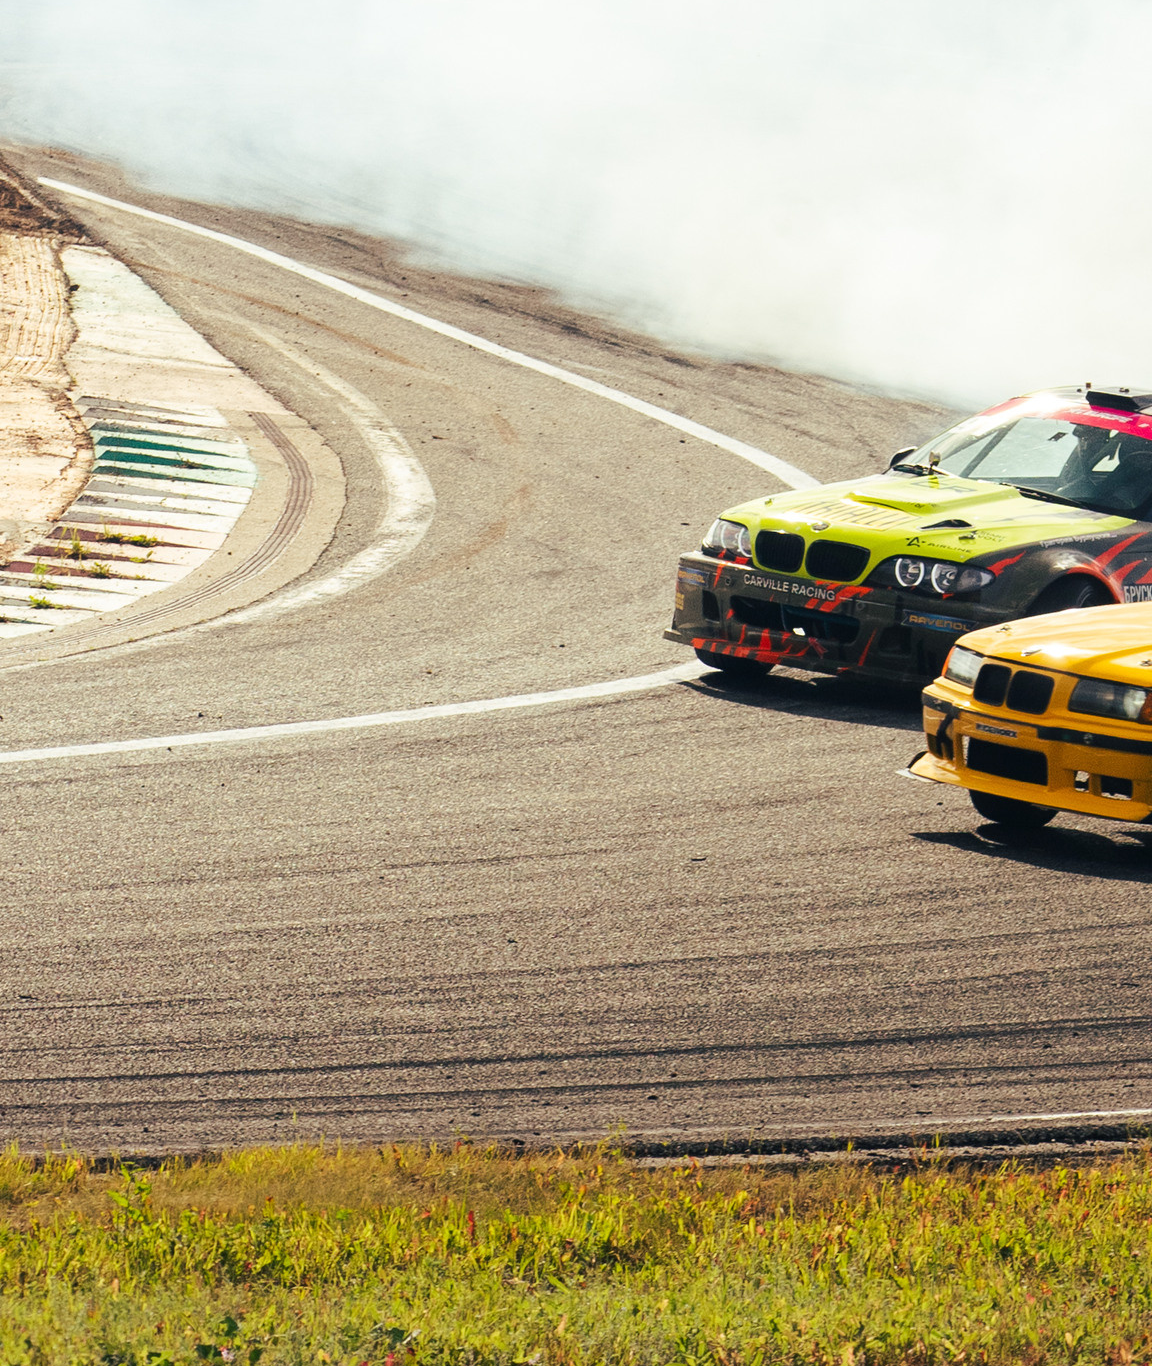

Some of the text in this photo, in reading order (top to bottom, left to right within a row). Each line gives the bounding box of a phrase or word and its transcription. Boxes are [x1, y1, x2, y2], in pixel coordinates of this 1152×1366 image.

[927, 542, 972, 554] AIRLINE
[743, 573, 836, 601] CARVILLE RACING
[908, 614, 971, 633] RAVENOL
